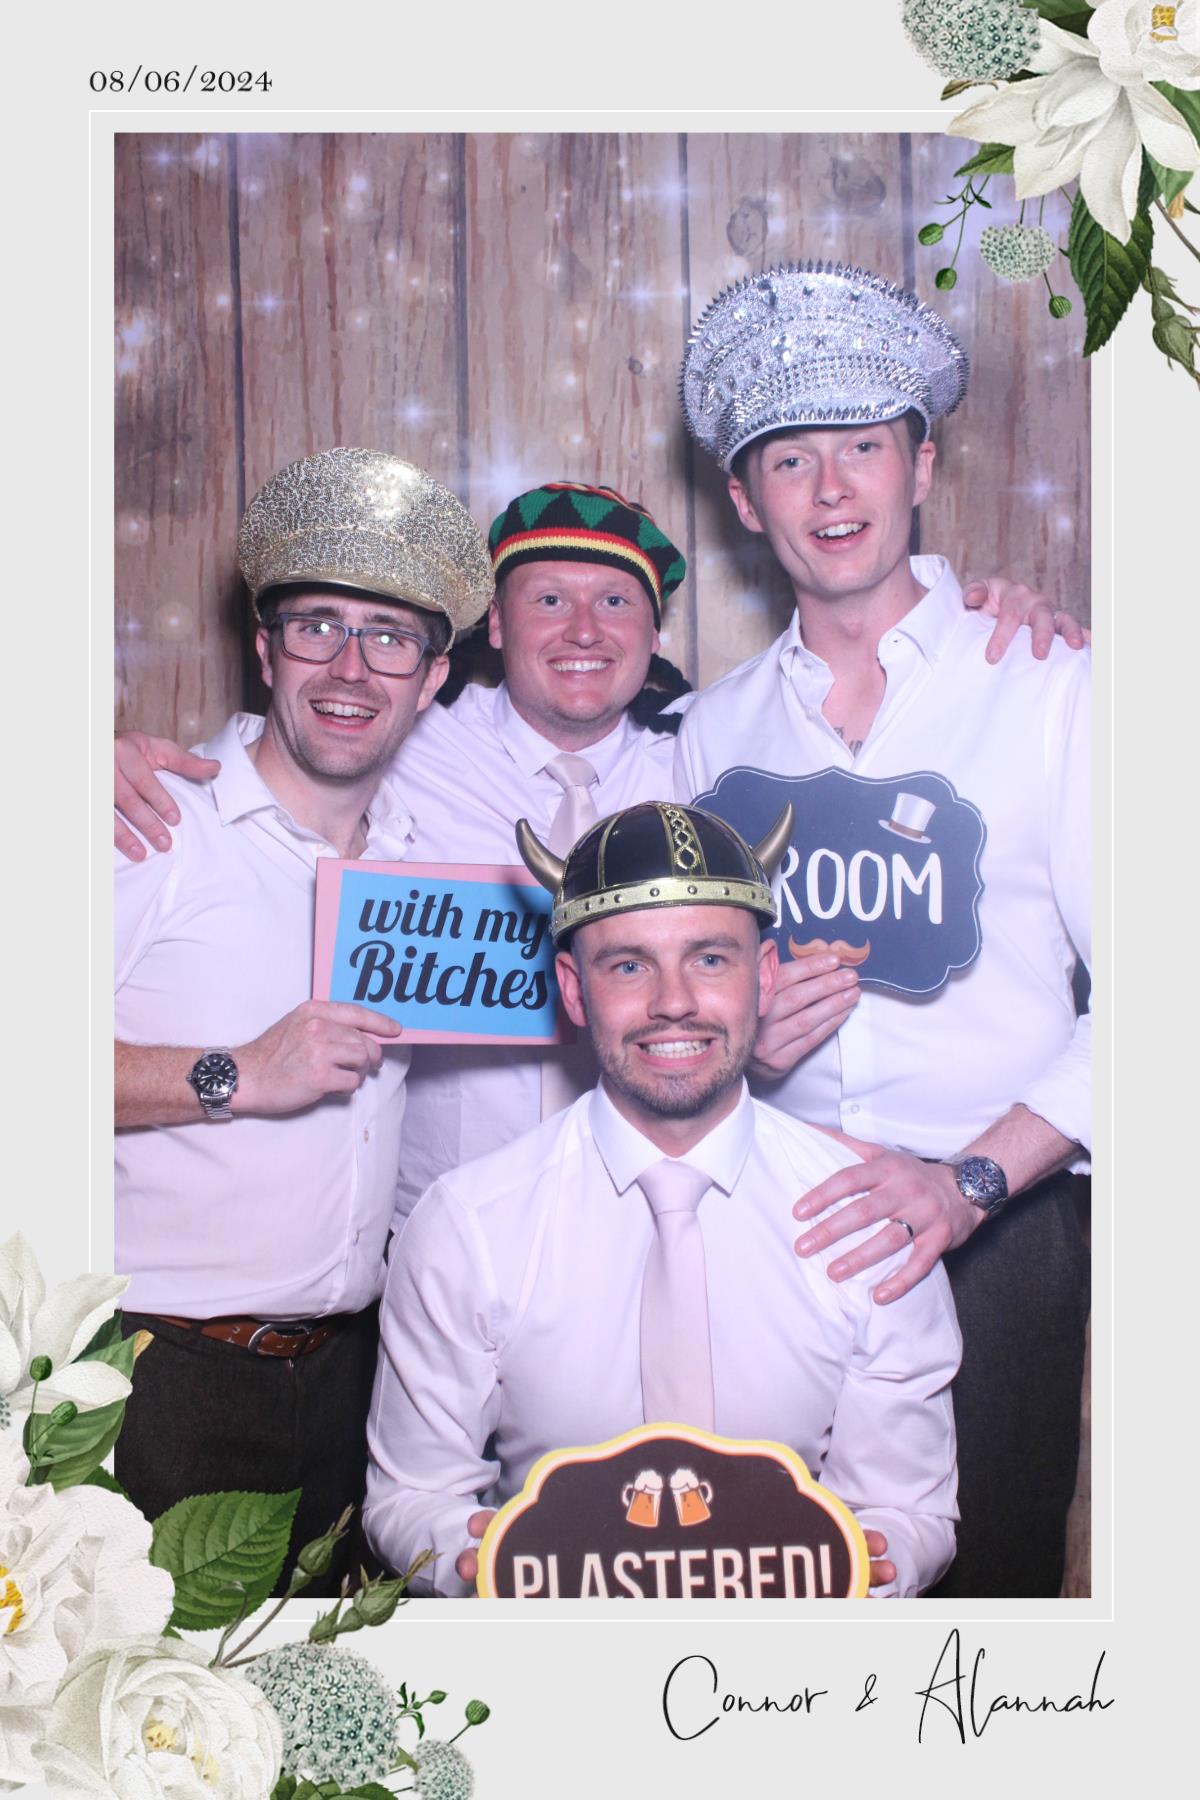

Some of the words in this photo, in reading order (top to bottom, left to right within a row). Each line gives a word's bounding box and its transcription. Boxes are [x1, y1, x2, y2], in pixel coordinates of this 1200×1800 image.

[772, 846, 944, 929] ROOM
[358, 889, 464, 940] with
[473, 908, 551, 961] my
[349, 940, 548, 1010] Bitches
